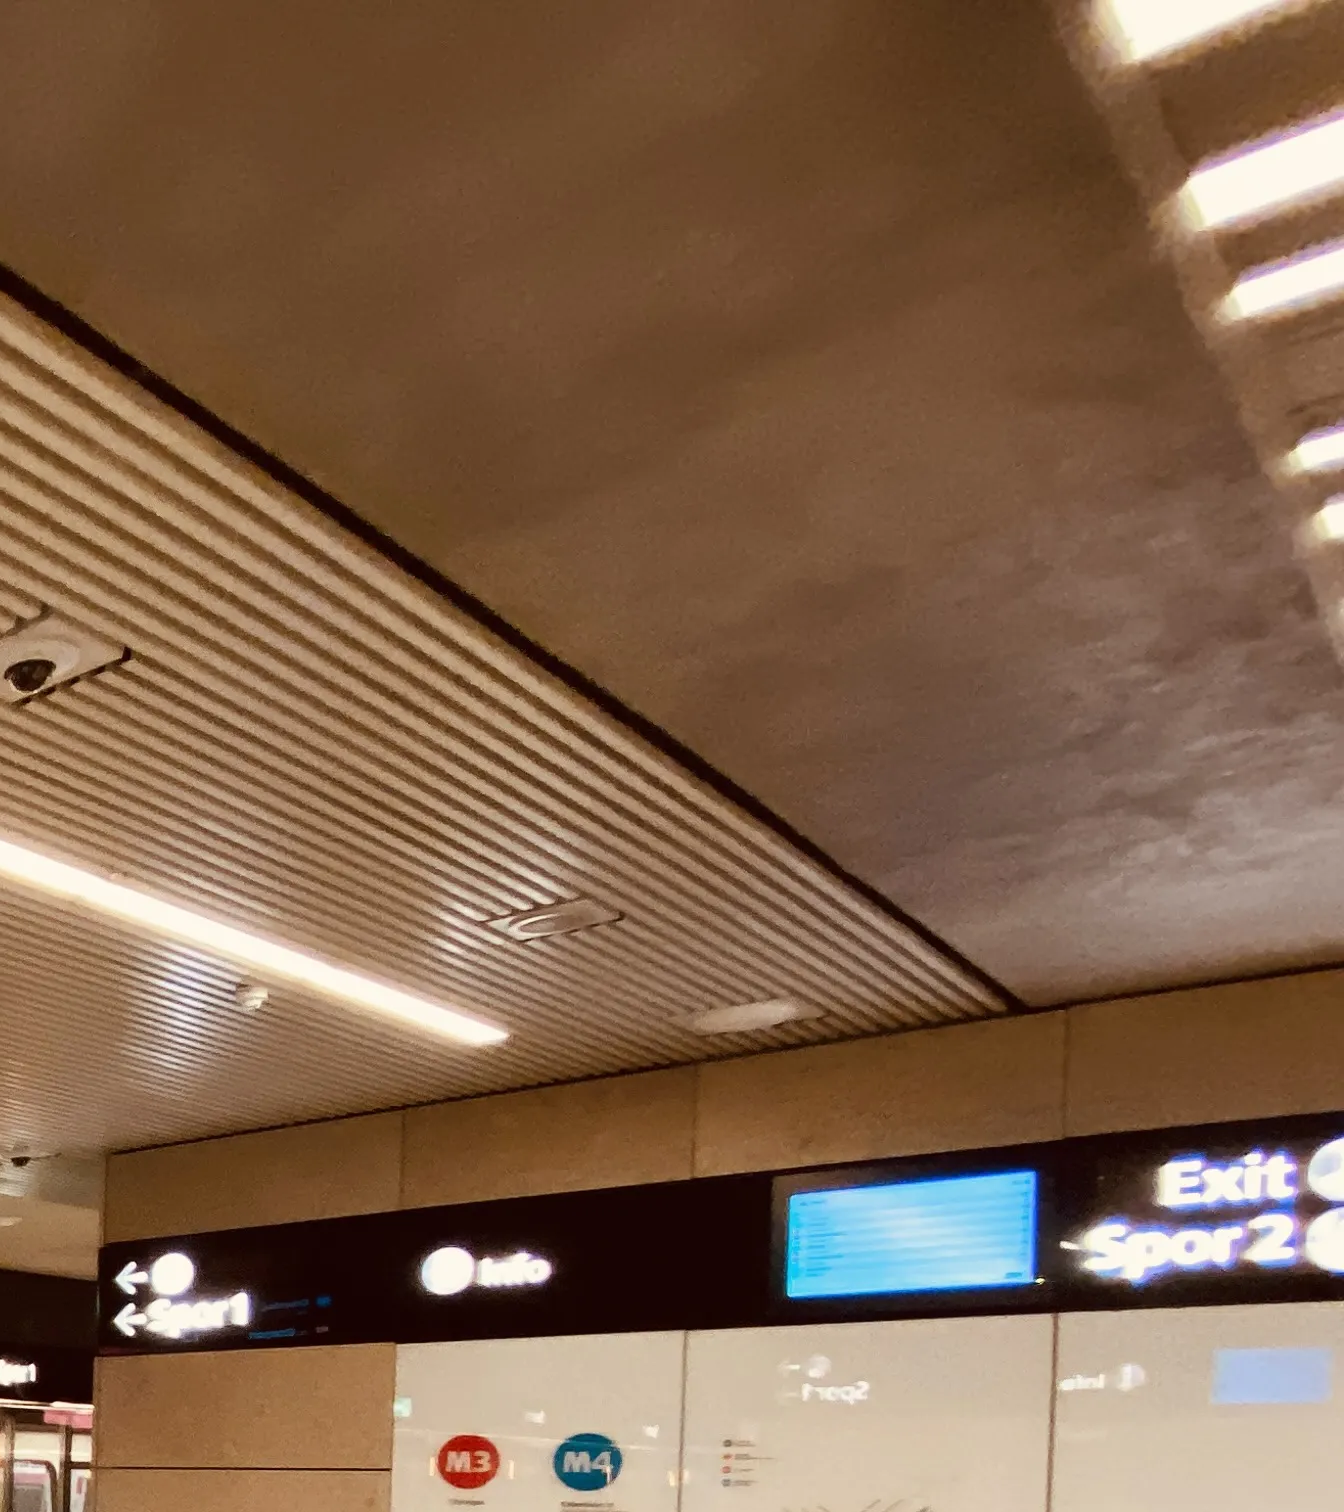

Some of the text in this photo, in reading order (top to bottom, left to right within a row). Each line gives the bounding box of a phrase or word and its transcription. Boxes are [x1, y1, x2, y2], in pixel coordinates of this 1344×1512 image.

[1158, 1152, 1297, 1207] Exit
[1083, 1222, 1244, 1280] Spor
[1241, 1213, 1296, 1262] 2
[145, 1291, 250, 1339] Spor 1
[445, 1450, 492, 1474] M3
[563, 1450, 614, 1475] M4
